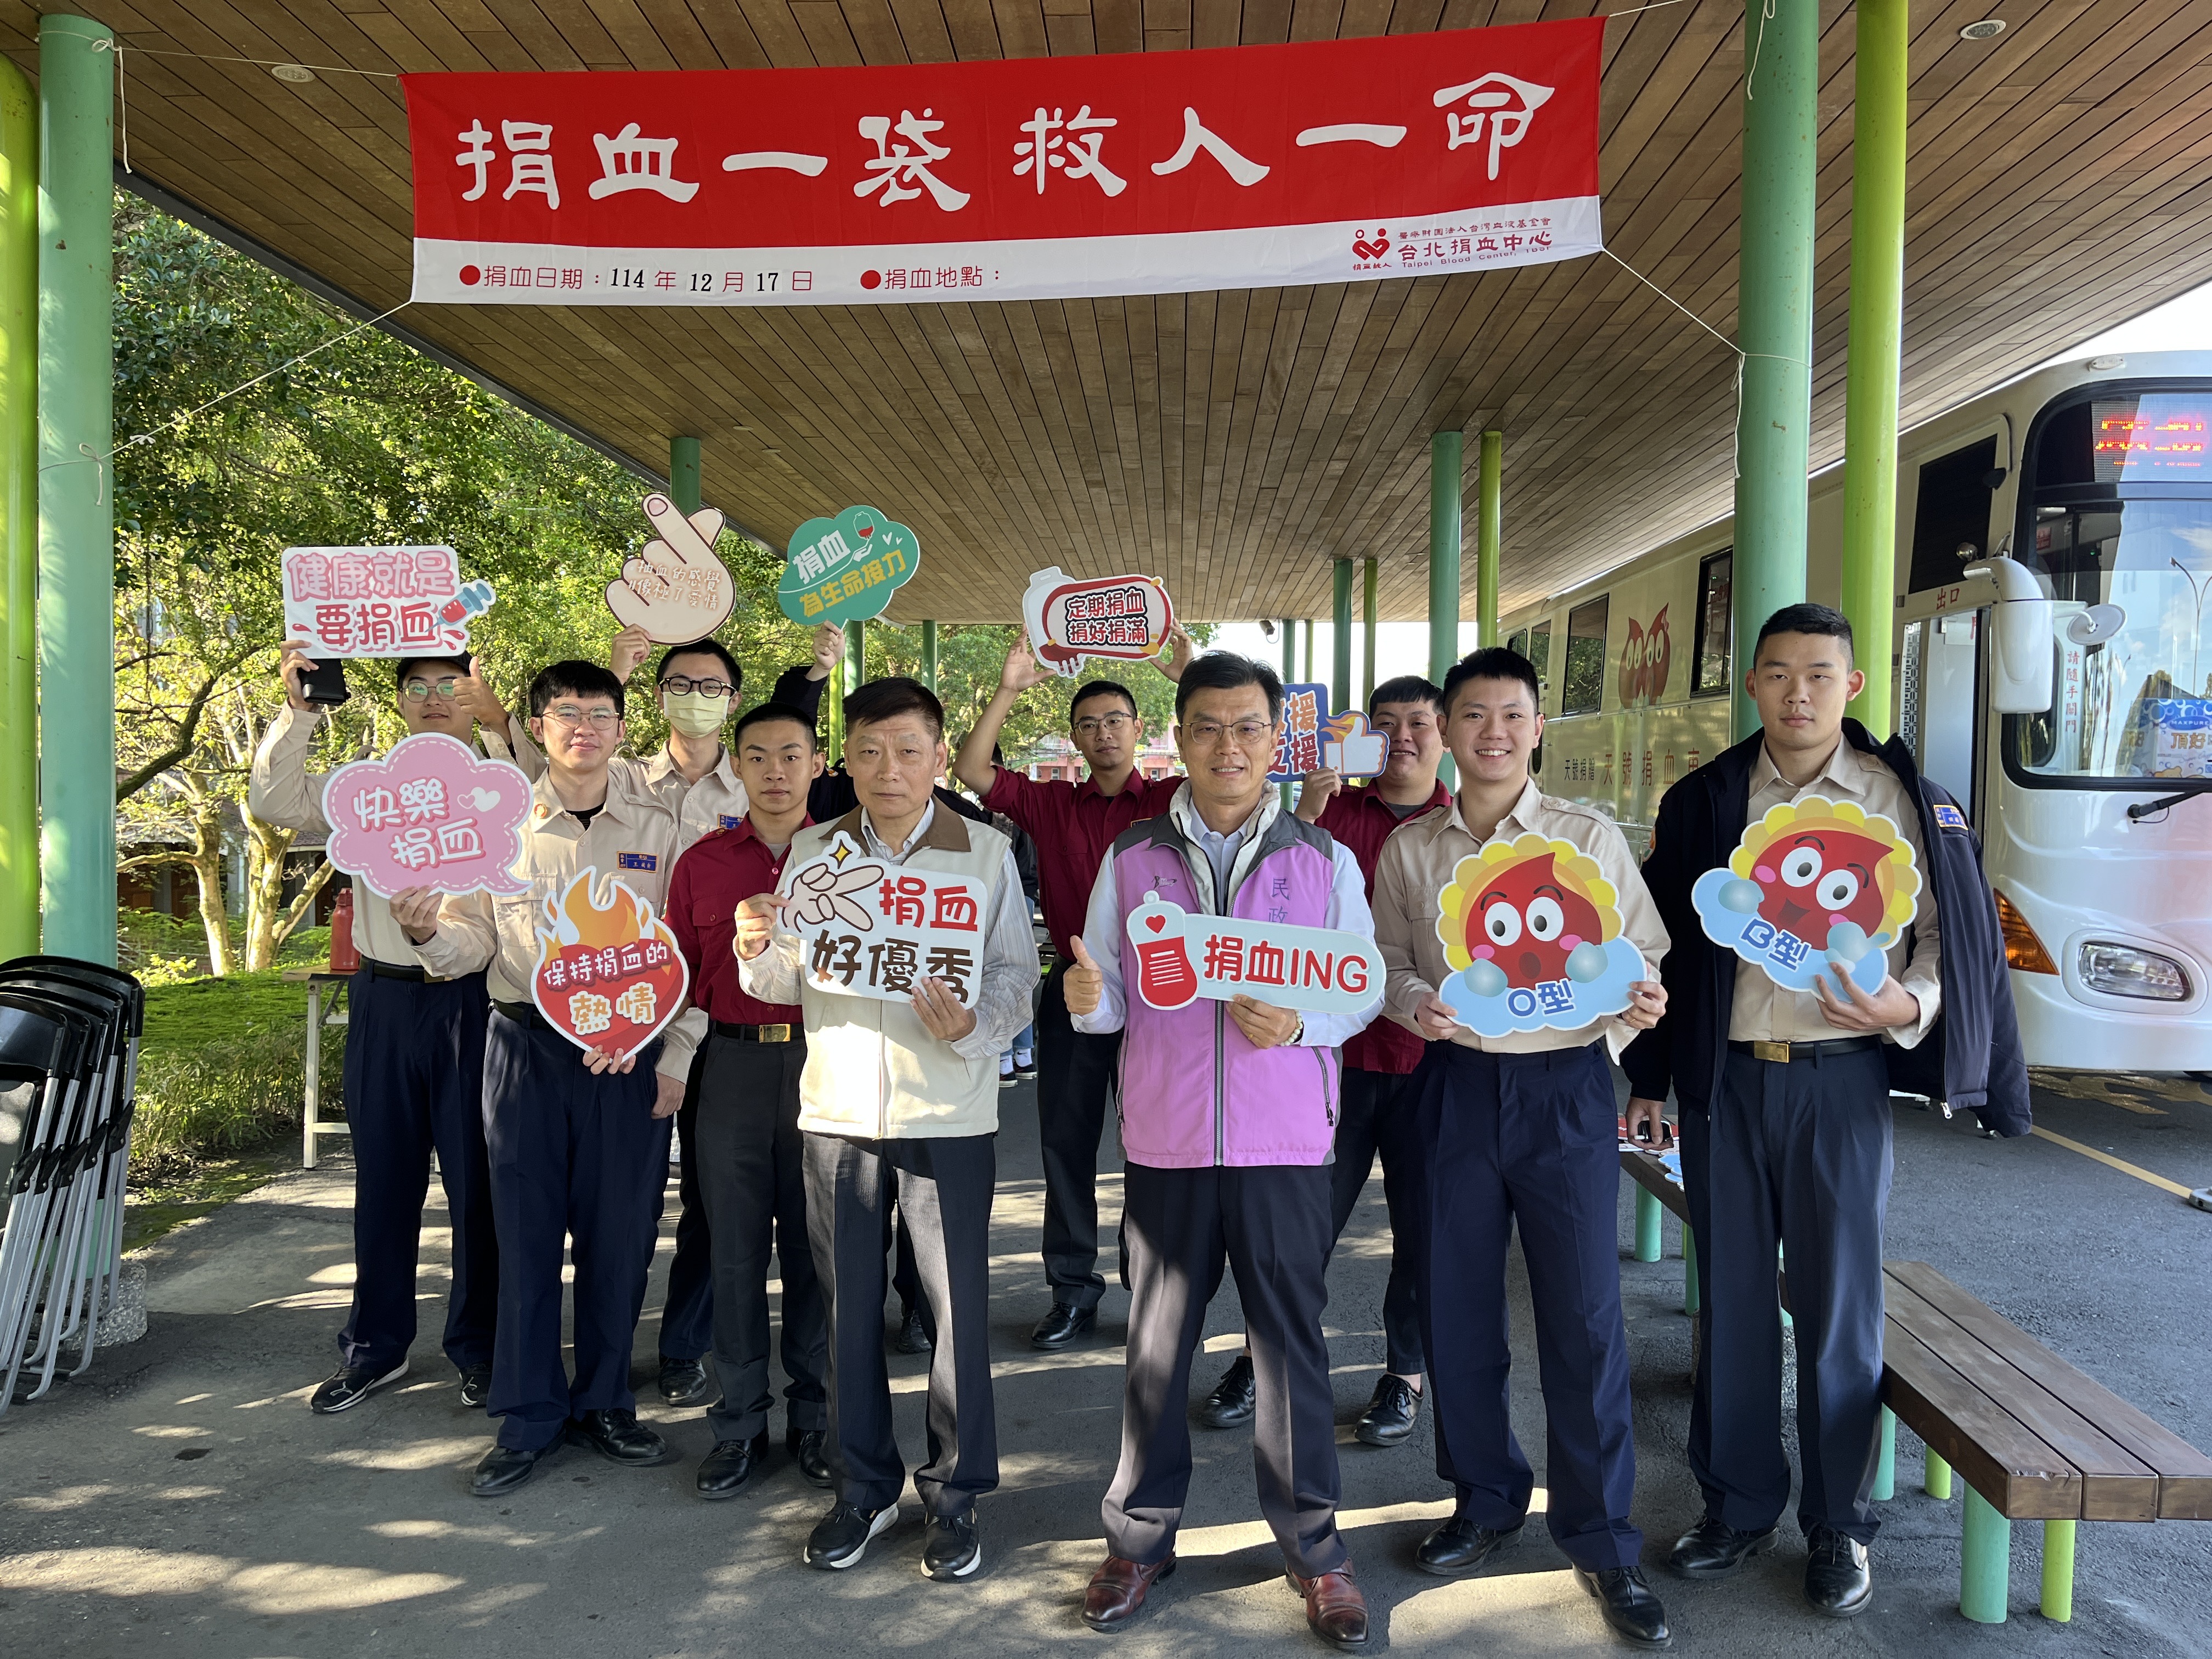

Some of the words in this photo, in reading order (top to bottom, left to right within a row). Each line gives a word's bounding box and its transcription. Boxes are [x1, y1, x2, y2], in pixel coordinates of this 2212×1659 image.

[455, 71, 1556, 212] 捐血一袋救人一命
[1397, 230, 1552, 261] 台北捐血中心
[1402, 259, 1432, 268] Taipei
[1441, 256, 1470, 264] Blood
[608, 267, 646, 289] 114
[653, 269, 678, 291] 年
[689, 272, 713, 293] 12
[721, 272, 743, 292] 月
[755, 271, 780, 292] 17
[792, 271, 812, 291] 日
[287, 551, 455, 602] 健康就是
[637, 559, 720, 592] 抽血的感覺
[792, 530, 851, 584] 捐血
[798, 549, 907, 617] 為生命接力
[1069, 589, 1144, 619] 定期捐血
[1936, 588, 1960, 611] 出口
[315, 602, 436, 646] 要捐血
[1069, 618, 1146, 644] 捐好捐滿
[354, 778, 446, 828] 快樂
[391, 818, 481, 868] 捐血
[879, 875, 978, 932] 捐血
[543, 941, 668, 987] 保持捐血的
[812, 929, 974, 1004] 好優秀
[1204, 934, 1368, 993] 捐血ING
[1740, 919, 1812, 972] B型
[572, 985, 654, 1031] 熱情
[1508, 979, 1574, 1017] O型
